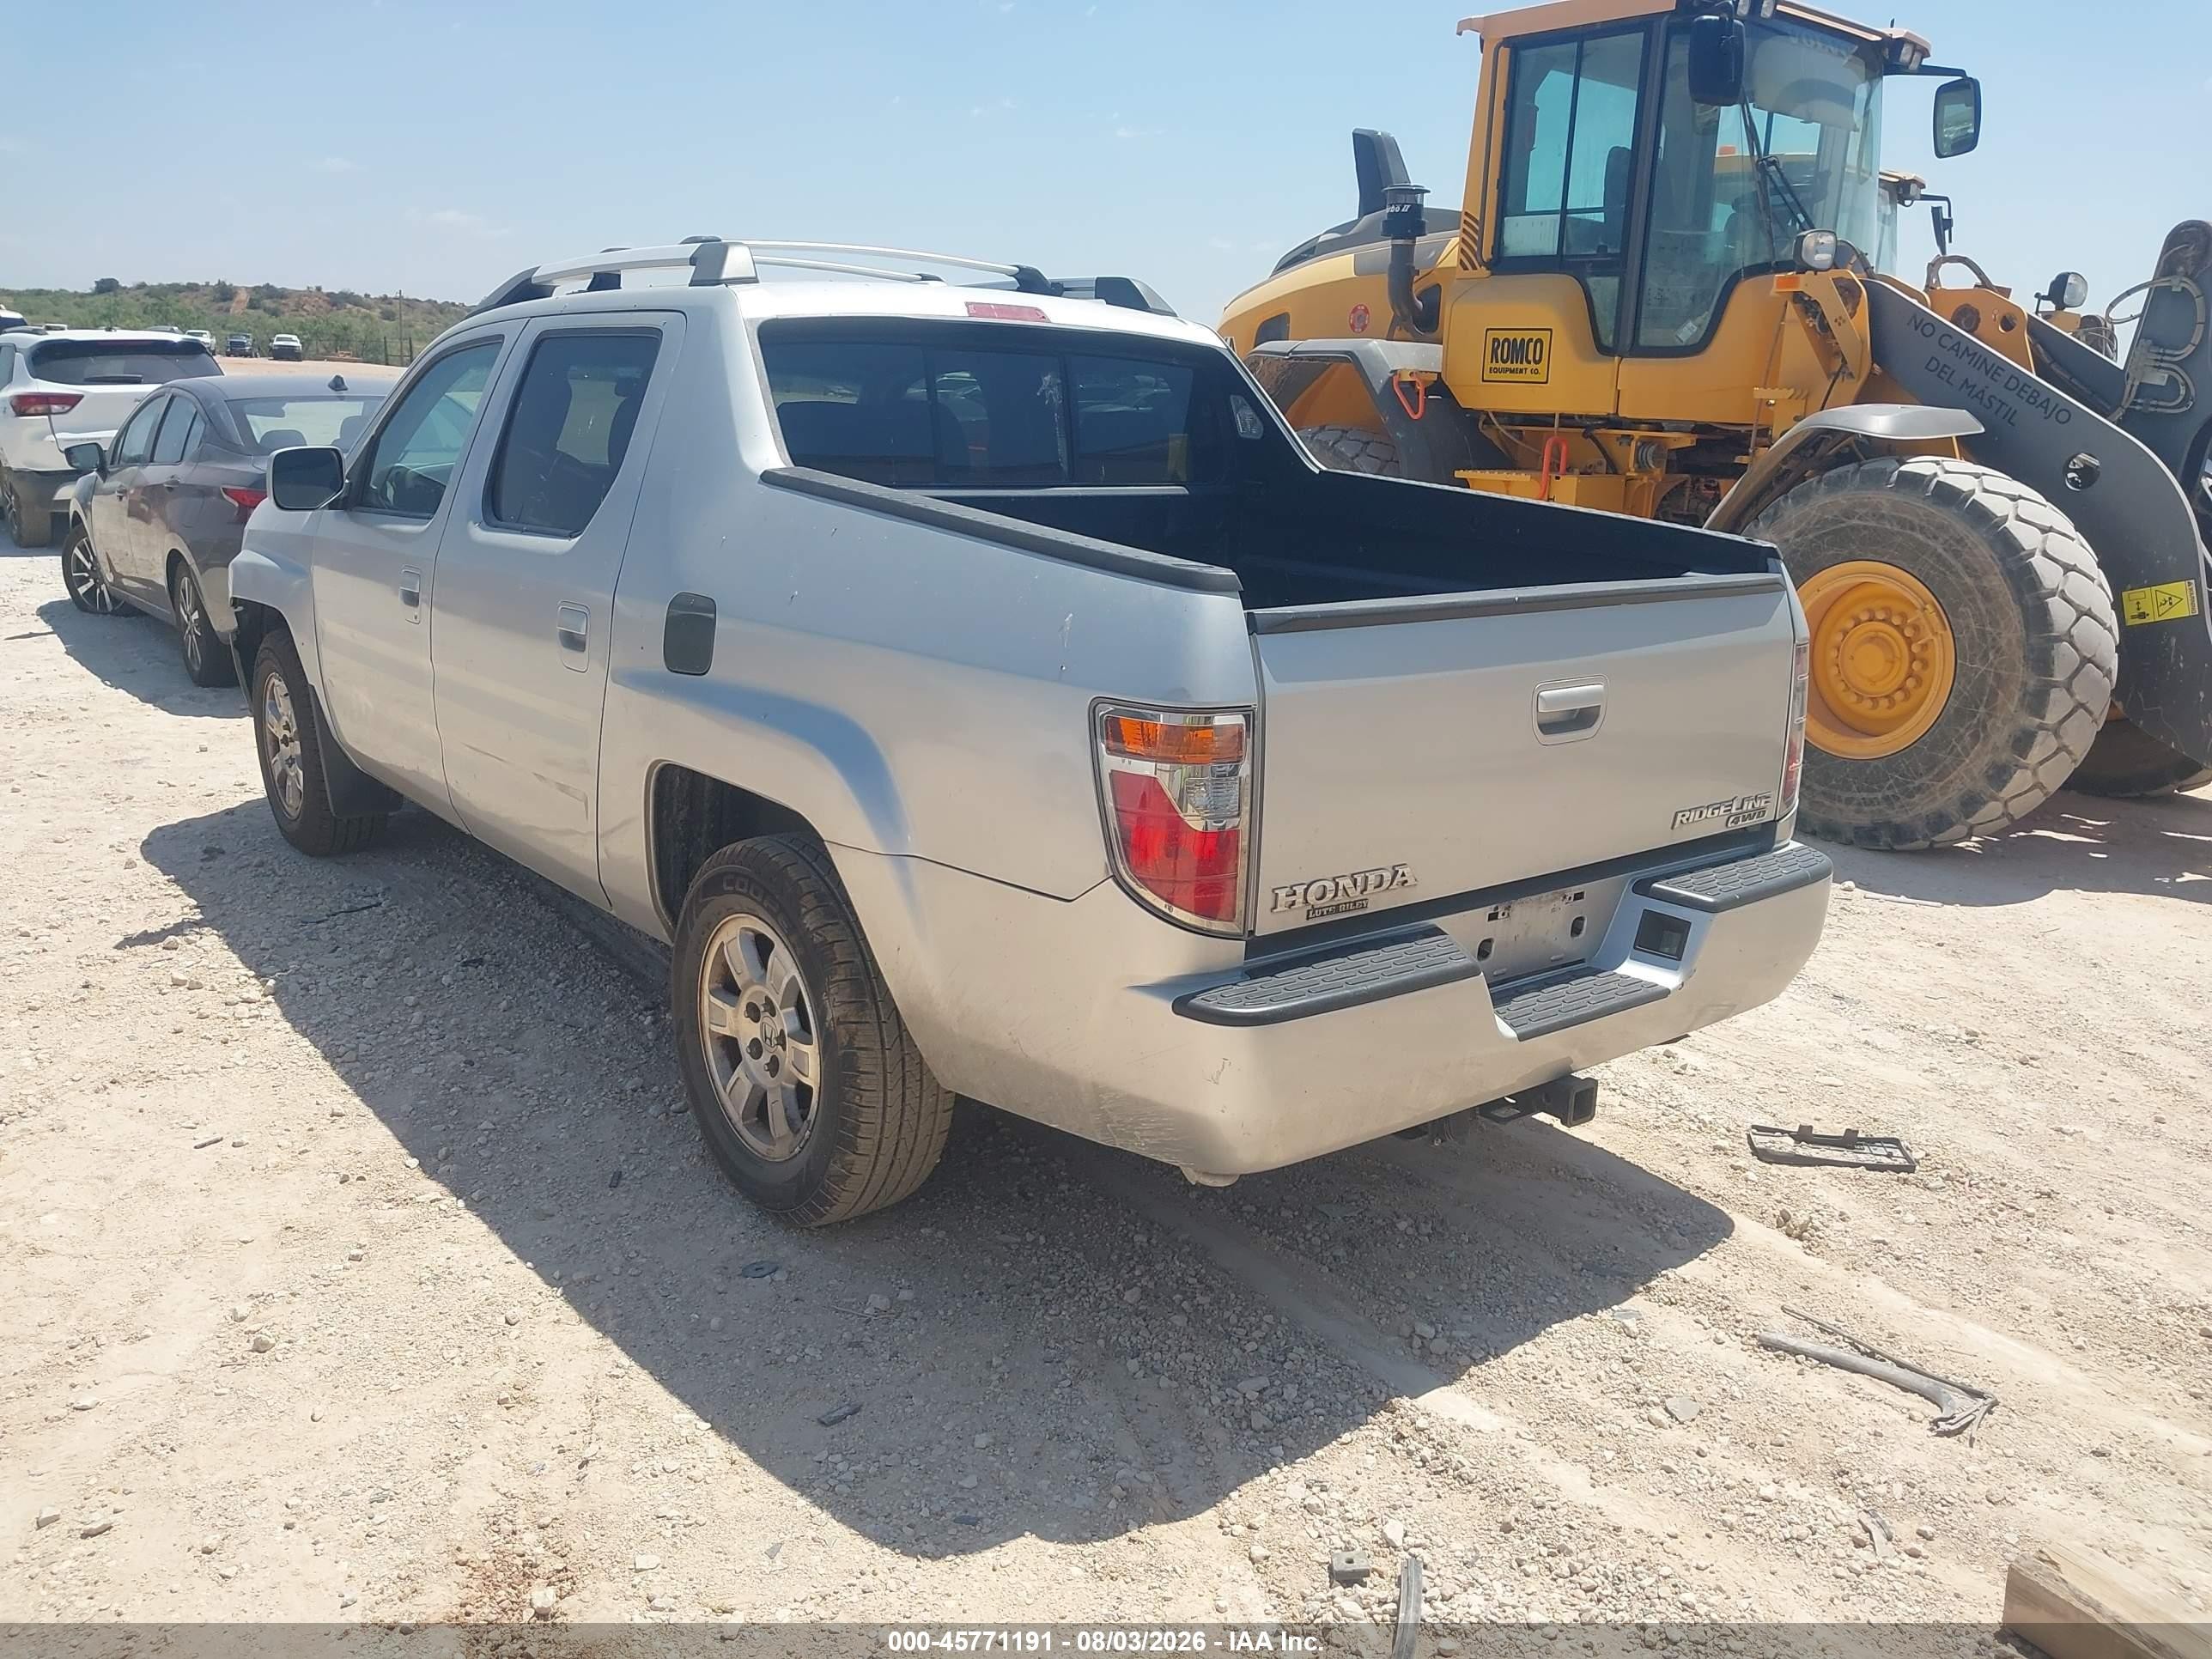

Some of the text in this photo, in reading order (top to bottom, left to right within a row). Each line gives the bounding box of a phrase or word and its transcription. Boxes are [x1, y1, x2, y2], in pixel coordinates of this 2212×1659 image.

[1490, 337, 1544, 365] ROMCO
[1906, 313, 2072, 425] NO CAMINE DEBAJO
[1924, 356, 2018, 426] DEL MÁSTIL
[1671, 791, 1772, 830] RIDGELINE
[1729, 810, 1767, 825] 4WD
[1271, 863, 1418, 913] HONDA
[1309, 899, 1369, 919] LUTE RILEY
